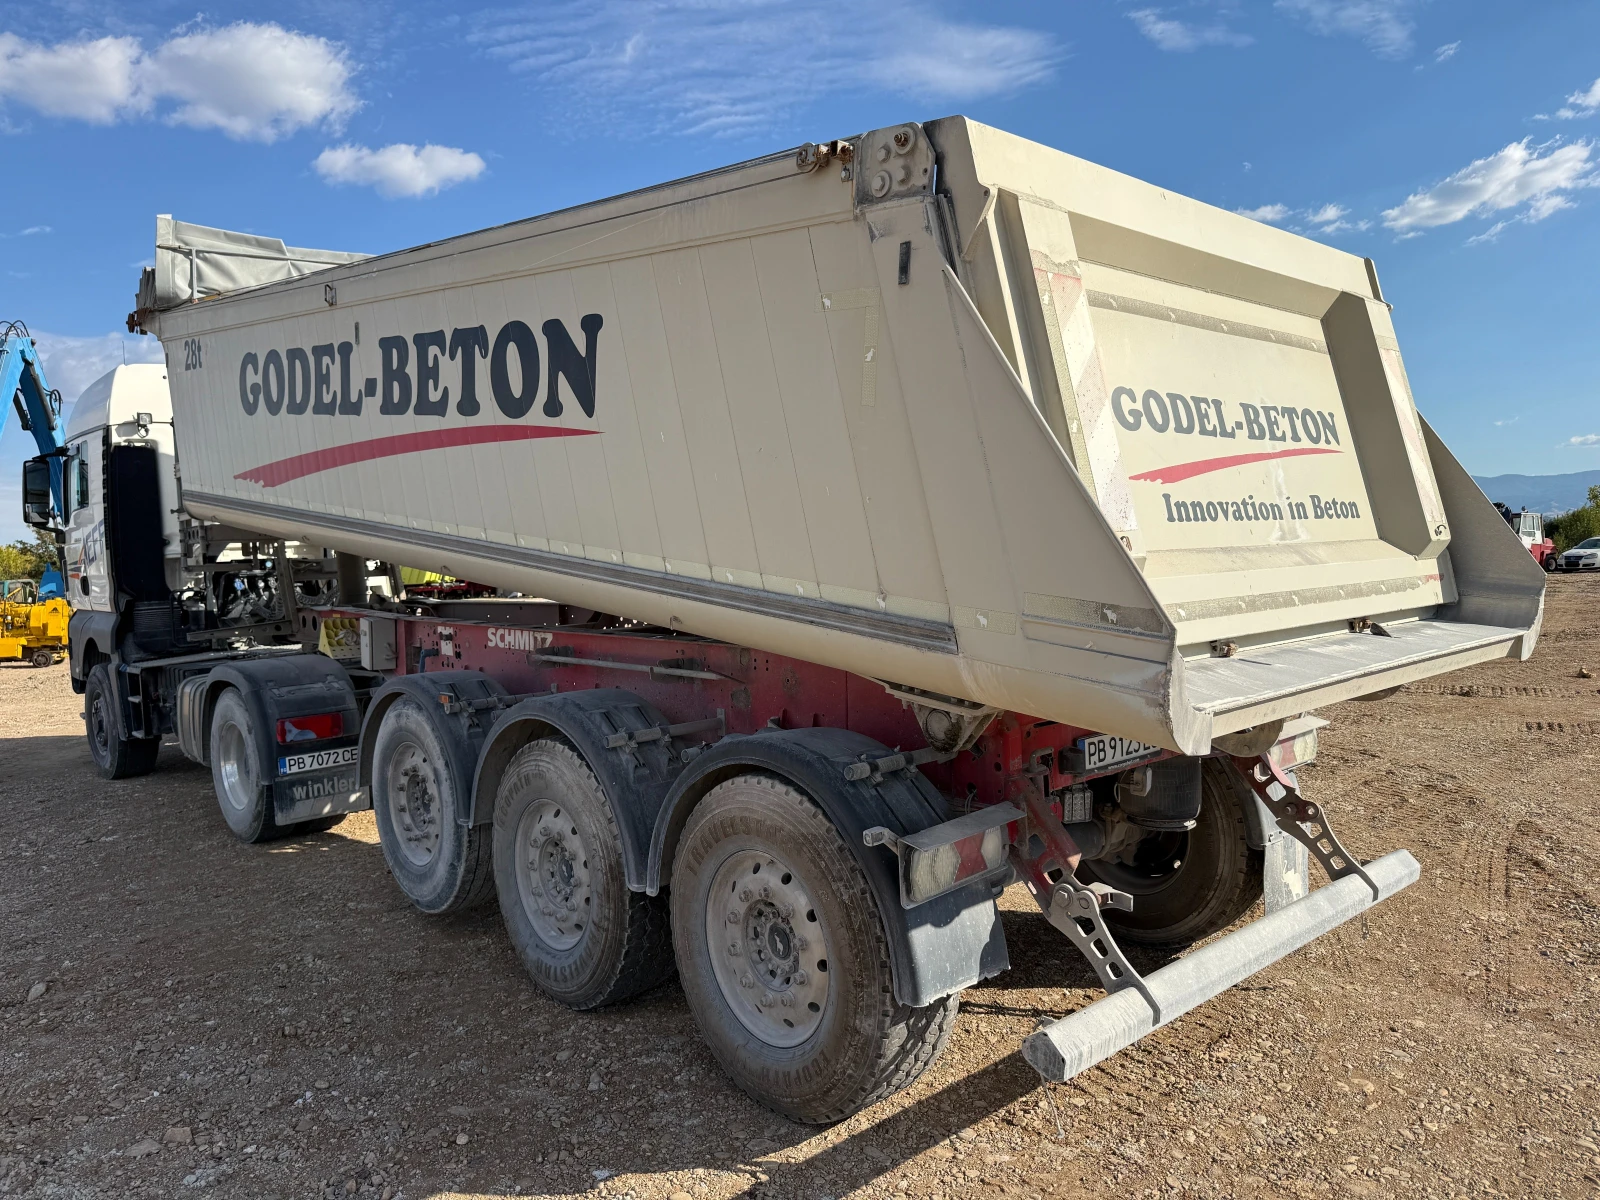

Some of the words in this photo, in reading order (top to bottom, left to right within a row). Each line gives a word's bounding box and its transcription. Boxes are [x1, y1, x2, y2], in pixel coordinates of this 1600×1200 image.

[184, 337, 202, 371] 28t
[239, 313, 604, 419] GODEL-BETON
[1111, 386, 1340, 446] GODEL-BETON
[1162, 493, 1284, 523] Innovation
[1286, 496, 1309, 520] in
[1309, 494, 1361, 520] Beton
[288, 757, 306, 771] PB
[308, 751, 340, 768] 7072
[342, 748, 358, 762] CE
[1087, 739, 1107, 766] PB
[293, 777, 356, 800] winkler
